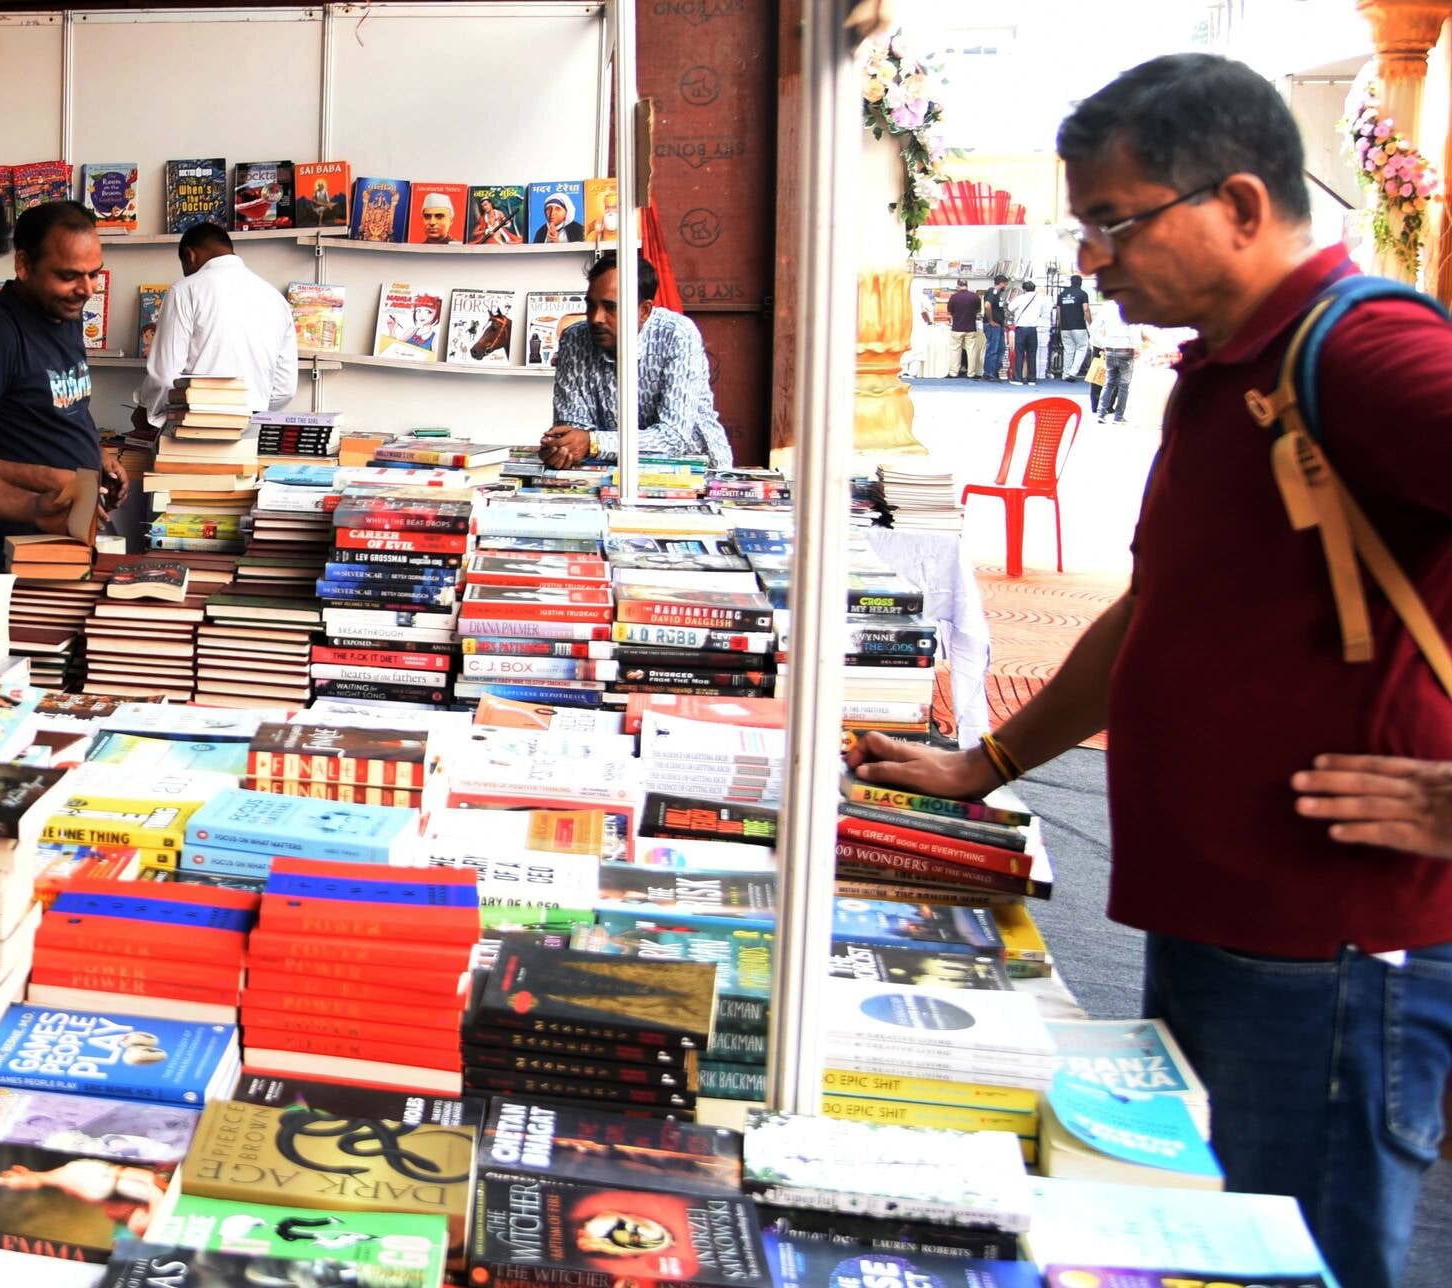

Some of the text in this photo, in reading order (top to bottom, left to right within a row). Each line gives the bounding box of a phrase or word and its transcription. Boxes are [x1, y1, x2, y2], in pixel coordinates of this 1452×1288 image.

[654, 141, 745, 157] SKY BOND
[299, 164, 341, 176] SAI BABA
[102, 178, 121, 186] Room
[179, 185, 212, 196] When's
[180, 201, 220, 213] Doctor?
[453, 298, 499, 312] HORSE
[284, 416, 297, 424] KISS
[307, 417, 319, 425] GIRL
[365, 516, 452, 528] WHEN THE BEAT DROPS
[348, 529, 400, 539] CAREER
[367, 540, 415, 551] OF EVIL
[355, 553, 408, 564] LEV GROSSMAN
[859, 597, 895, 606] CROSS
[654, 605, 709, 616] RADIANT
[711, 609, 742, 620] KING
[850, 605, 903, 614] MY HEART
[469, 621, 539, 635] DIANA PALMER
[650, 613, 733, 628] DAVID DALGLISH
[338, 626, 404, 638] BREAKTHROUGH
[342, 638, 373, 647] EXPOSED
[501, 662, 533, 673] BOX
[648, 670, 695, 679] DIVORCED
[341, 669, 371, 680] hearts
[392, 671, 427, 684] fathers
[336, 682, 369, 692] WAITING
[539, 691, 587, 700] HYPOTHESIS
[271, 756, 355, 773] FINALE
[862, 789, 970, 816] BLACK HOLES
[60, 827, 87, 846] ONE
[89, 830, 131, 850] THING
[214, 833, 303, 851] FOCUS ON WHAT MATTERS
[847, 828, 987, 864] THE GREAT BOOK OF EVERYTHING
[211, 857, 268, 870] FOCUS ON WHAT
[526, 865, 555, 884] CEO
[647, 886, 675, 901] THE
[72, 973, 146, 994] POWER
[7, 1012, 70, 1074] GAMES
[37, 1014, 98, 1077] PEOPLE
[67, 1016, 137, 1081] PLAY
[710, 1030, 764, 1052] BACKMAN
[840, 1074, 901, 1092] EPIC SHIT
[846, 1102, 875, 1117] EPIC
[878, 1106, 906, 1120] SHIT
[212, 1102, 247, 1155] PIERCE
[241, 1106, 272, 1161] BROWN
[491, 1103, 527, 1164] CHETAN
[520, 1105, 557, 1168] BHAGAT
[196, 1158, 446, 1206] DARK AGE
[486, 1207, 508, 1233] THE
[504, 1183, 543, 1261] WITCHER
[686, 1207, 718, 1268] ANDRZEJ
[707, 1199, 748, 1279] SAPKOWSKI
[497, 1262, 609, 1288] THE WITCHER
